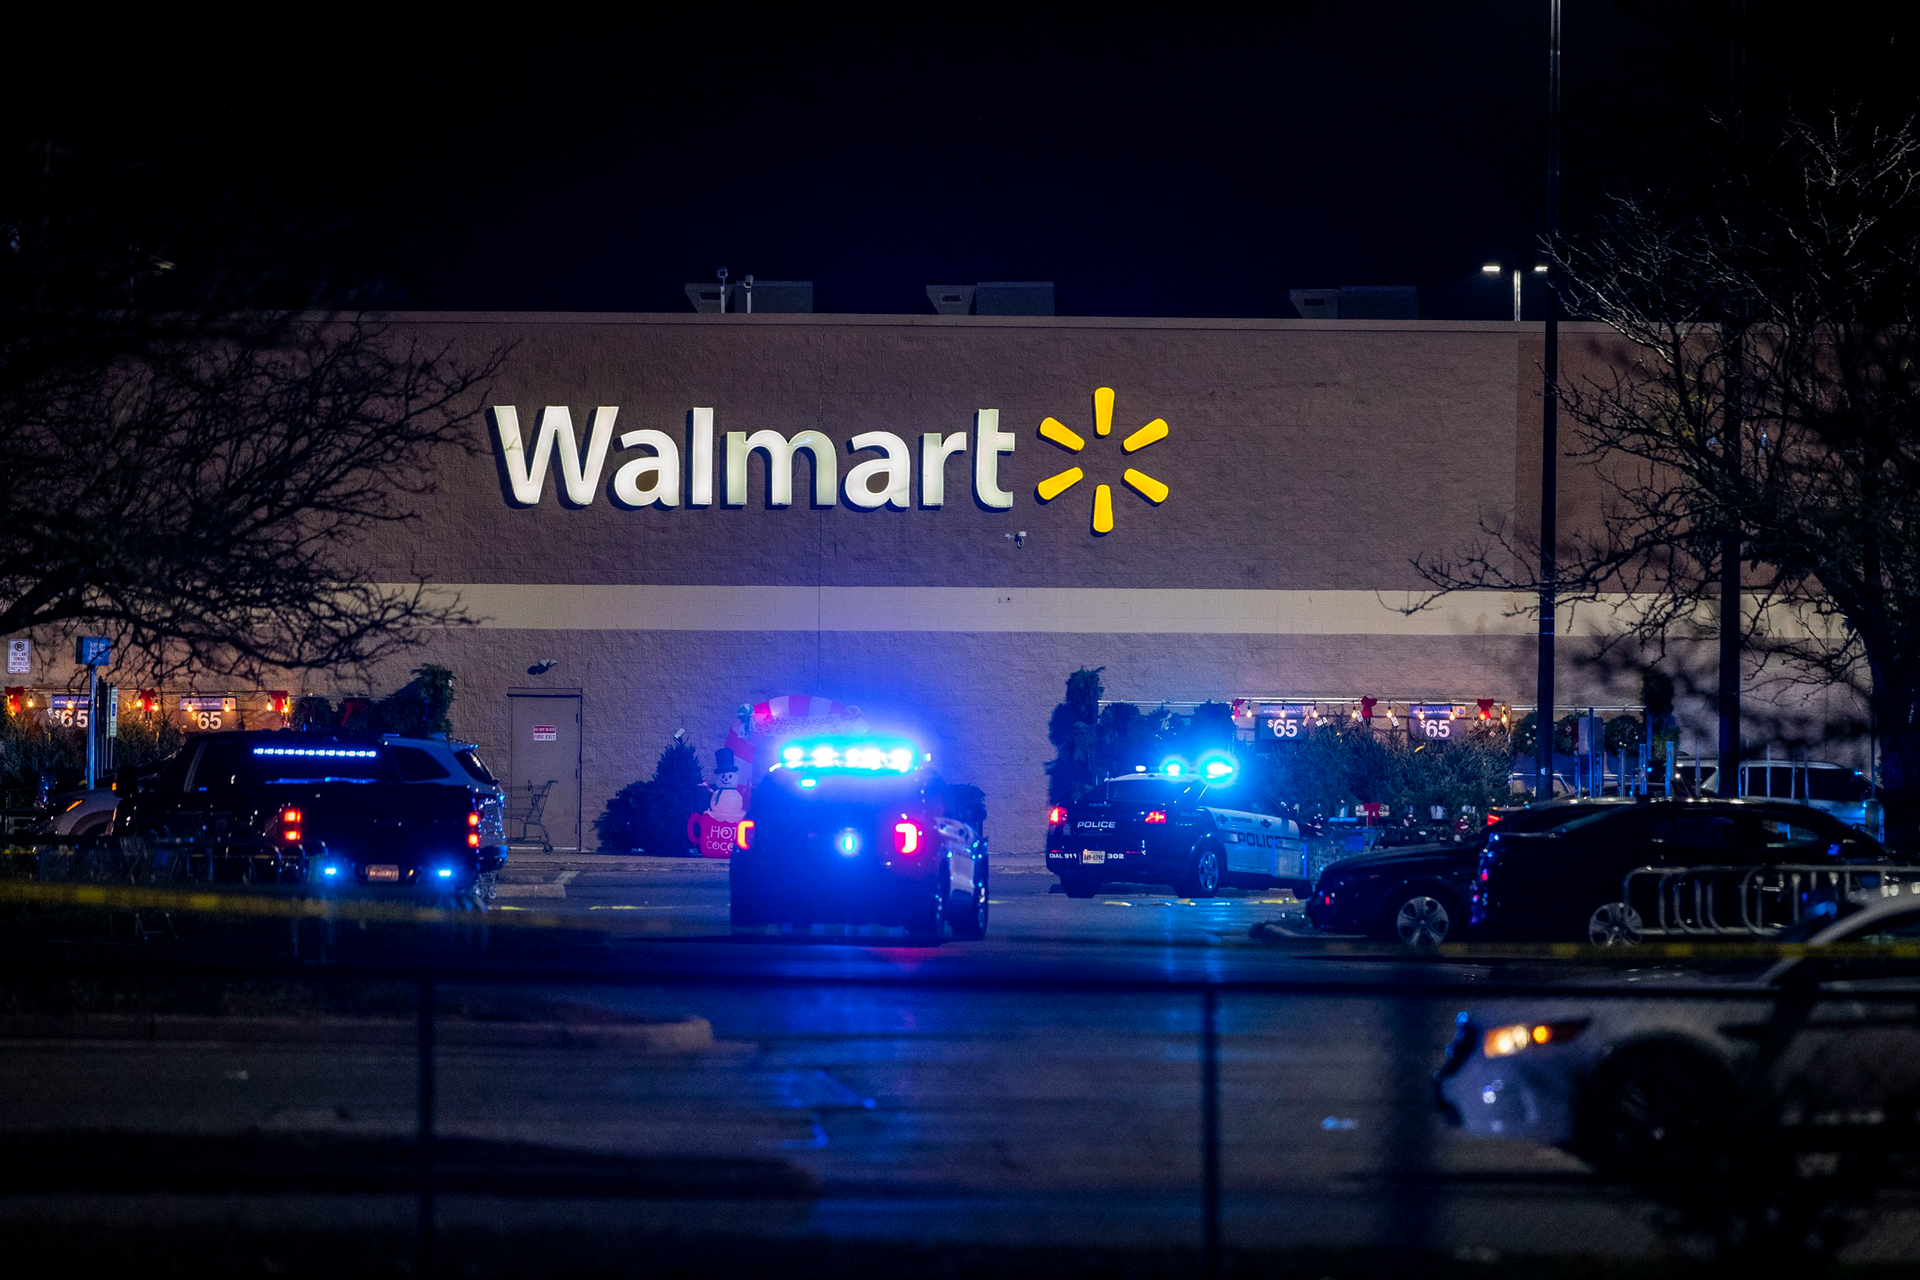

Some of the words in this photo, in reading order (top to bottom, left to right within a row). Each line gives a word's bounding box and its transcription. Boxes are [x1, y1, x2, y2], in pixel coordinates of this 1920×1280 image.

[492, 405, 1016, 509] Walmart
[54, 709, 88, 728] $65
[191, 711, 222, 730] $65
[801, 716, 834, 727] SUGAR
[1267, 719, 1298, 738] $65
[1420, 719, 1451, 738] $65
[710, 825, 737, 840] HOT
[1077, 821, 1116, 829] POLICE
[706, 840, 734, 852] COCO
